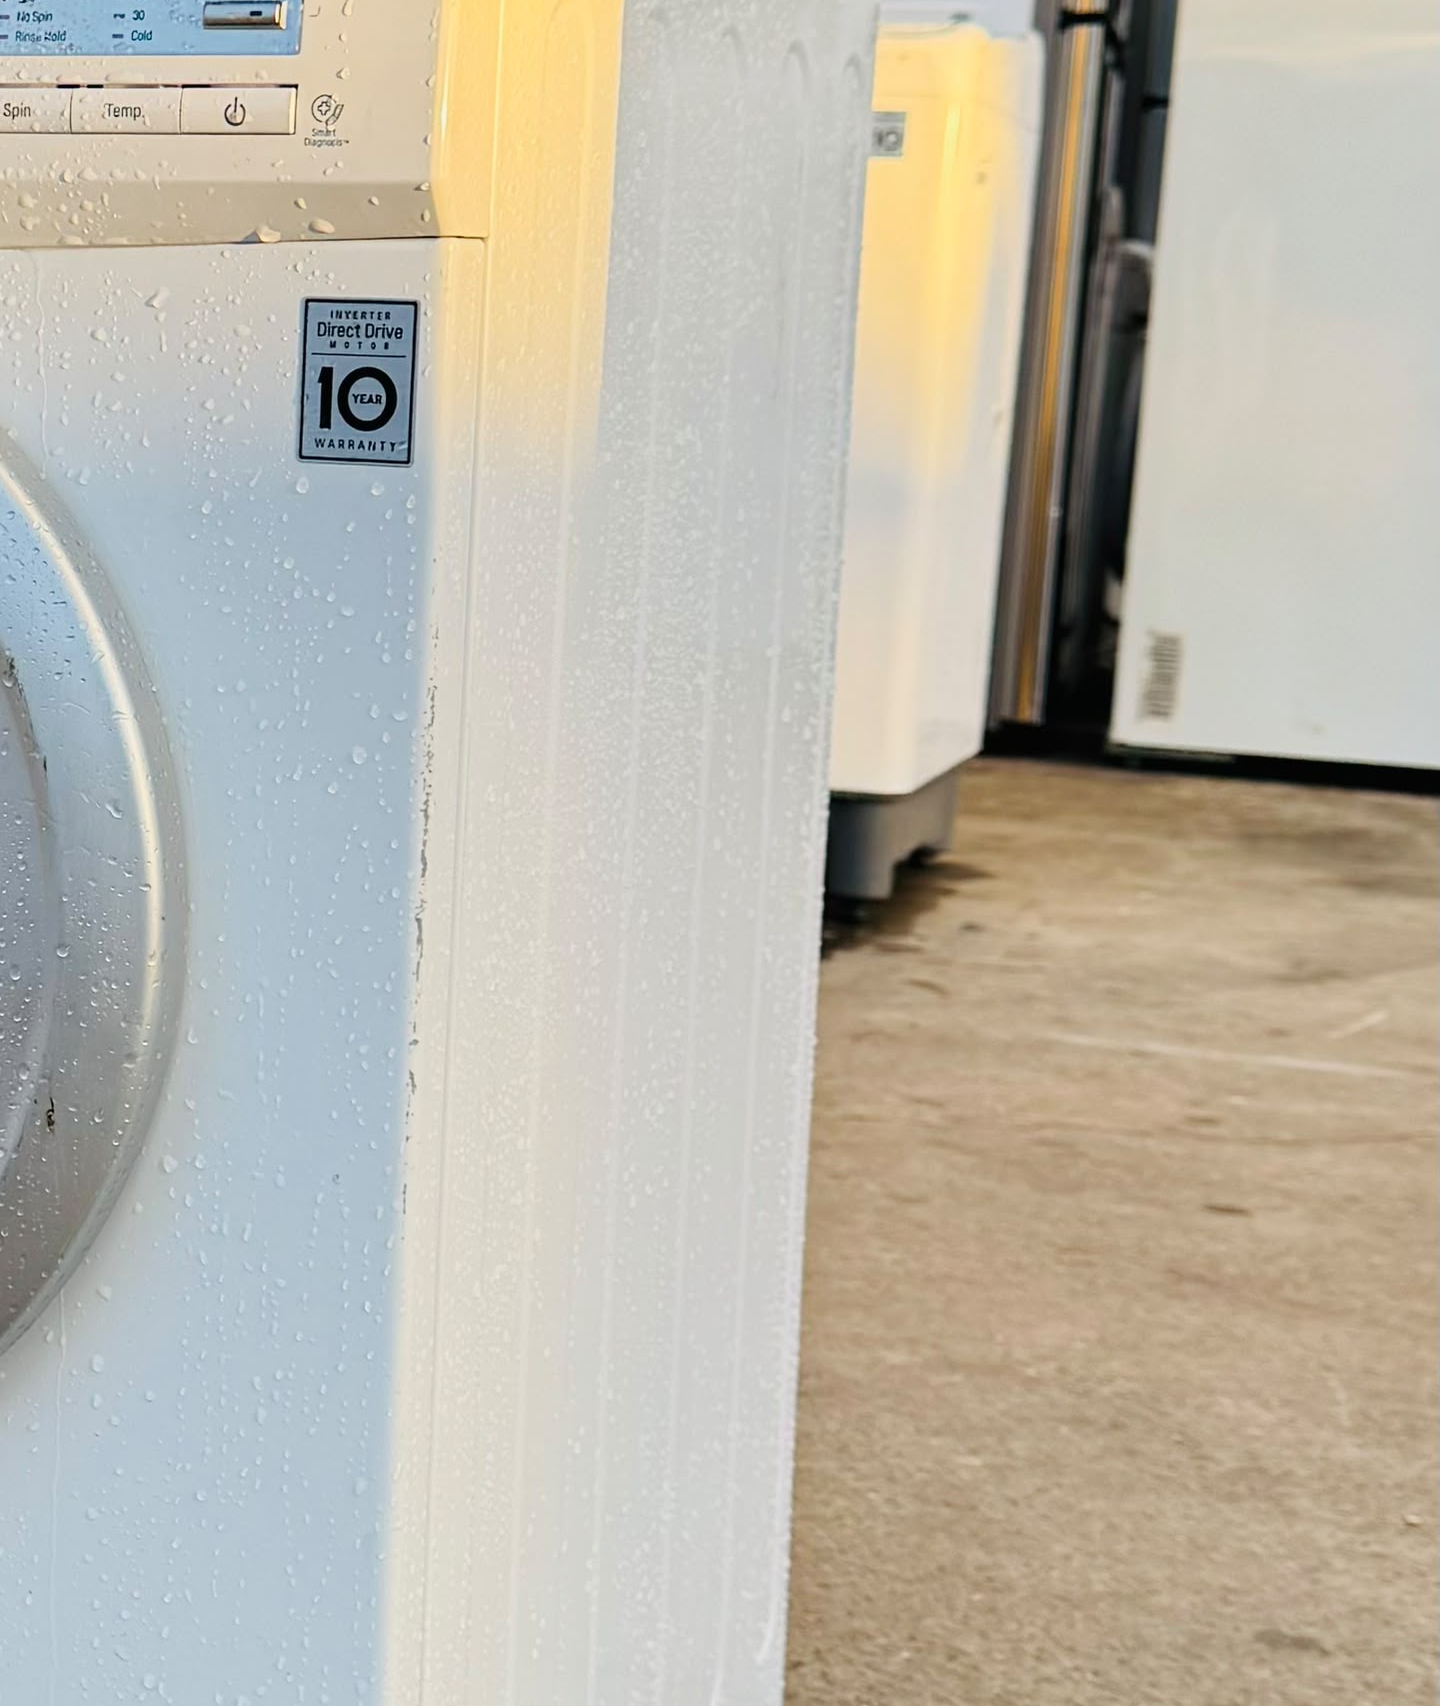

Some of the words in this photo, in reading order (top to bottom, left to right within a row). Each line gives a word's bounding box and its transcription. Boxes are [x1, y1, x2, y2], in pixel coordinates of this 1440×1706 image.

[32, 12, 53, 24] Spin
[132, 10, 145, 21] 30
[15, 31, 42, 43] Rinse
[131, 30, 153, 41] Cold
[3, 102, 31, 120] Spin
[106, 102, 145, 121] Temp.
[330, 310, 392, 321] INVERTER
[317, 321, 360, 339] Direct
[365, 323, 404, 340] Drive
[329, 340, 390, 350] MOTOR
[317, 366, 398, 432] 10
[352, 393, 383, 405] YEAR
[314, 438, 397, 453] WARRANTY
